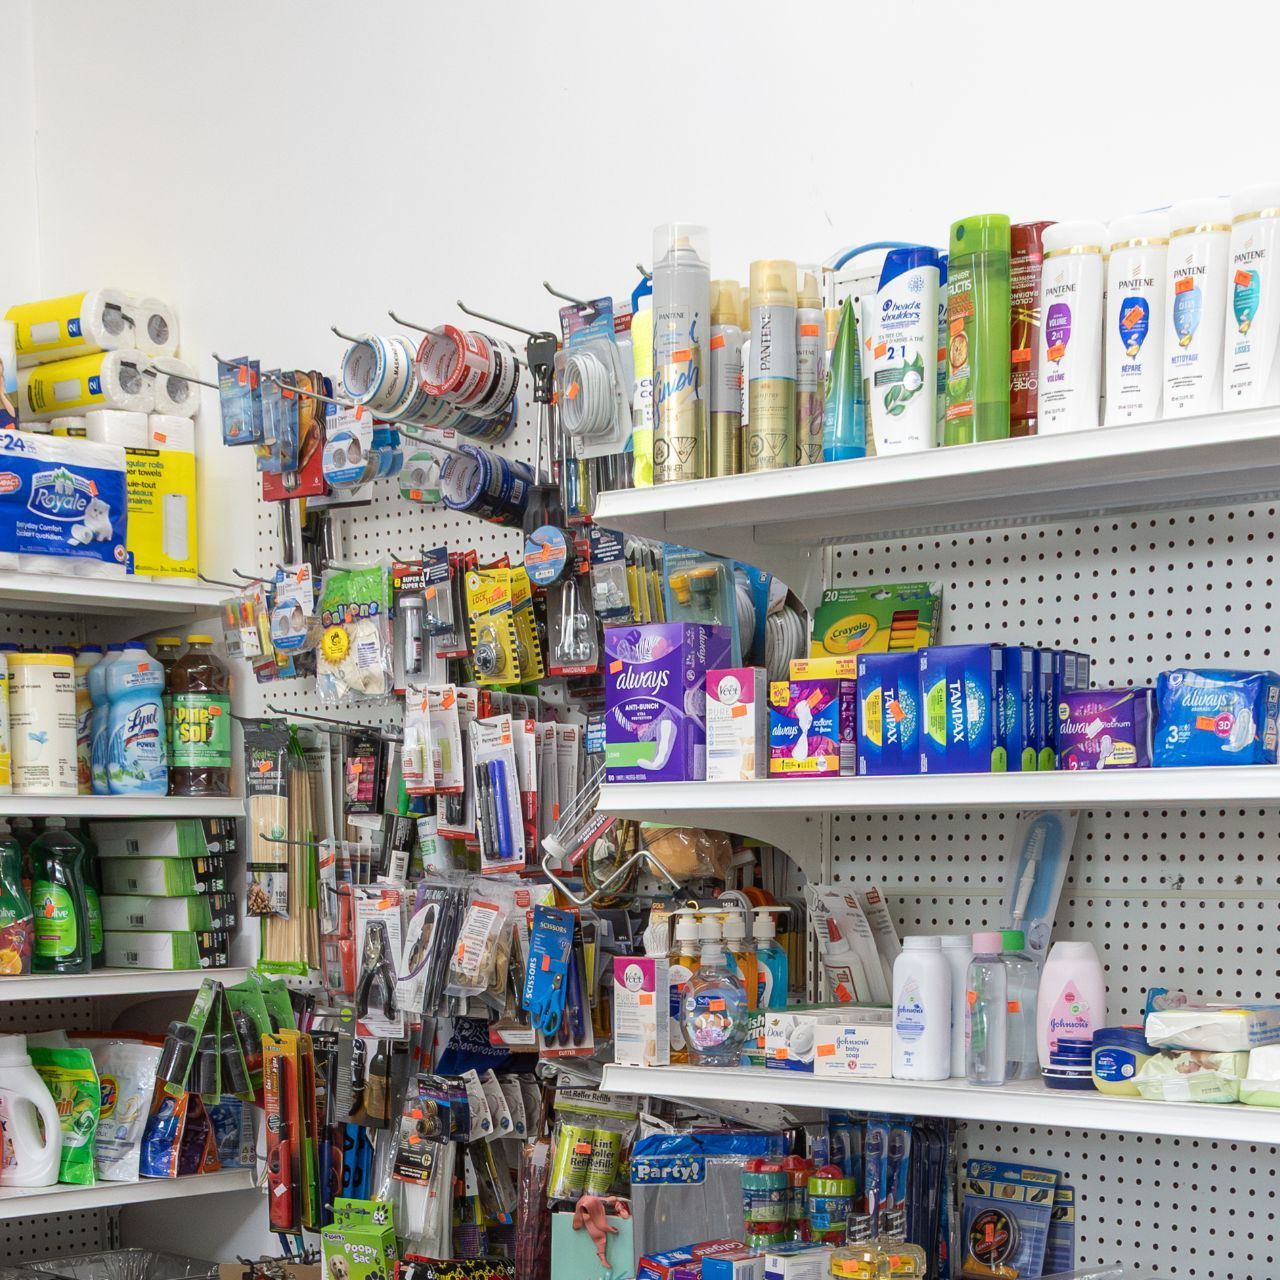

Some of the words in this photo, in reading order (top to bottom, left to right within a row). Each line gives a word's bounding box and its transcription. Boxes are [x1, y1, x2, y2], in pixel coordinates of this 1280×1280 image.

[1233, 249, 1266, 265] PANTENE
[1119, 278, 1155, 290] PANTENE
[881, 309, 921, 322] shoulders
[36, 490, 87, 512] Royale
[825, 590, 838, 602] 20
[832, 621, 868, 639] Crayola
[616, 665, 669, 691] always
[1182, 694, 1228, 710] always
[128, 706, 158, 734] Lysol
[949, 680, 963, 744] TAMPAX
[179, 723, 208, 742] Sol
[540, 920, 567, 934] SCISSORS
[767, 1027, 784, 1040] Dove
[637, 1162, 700, 1184] Party!
